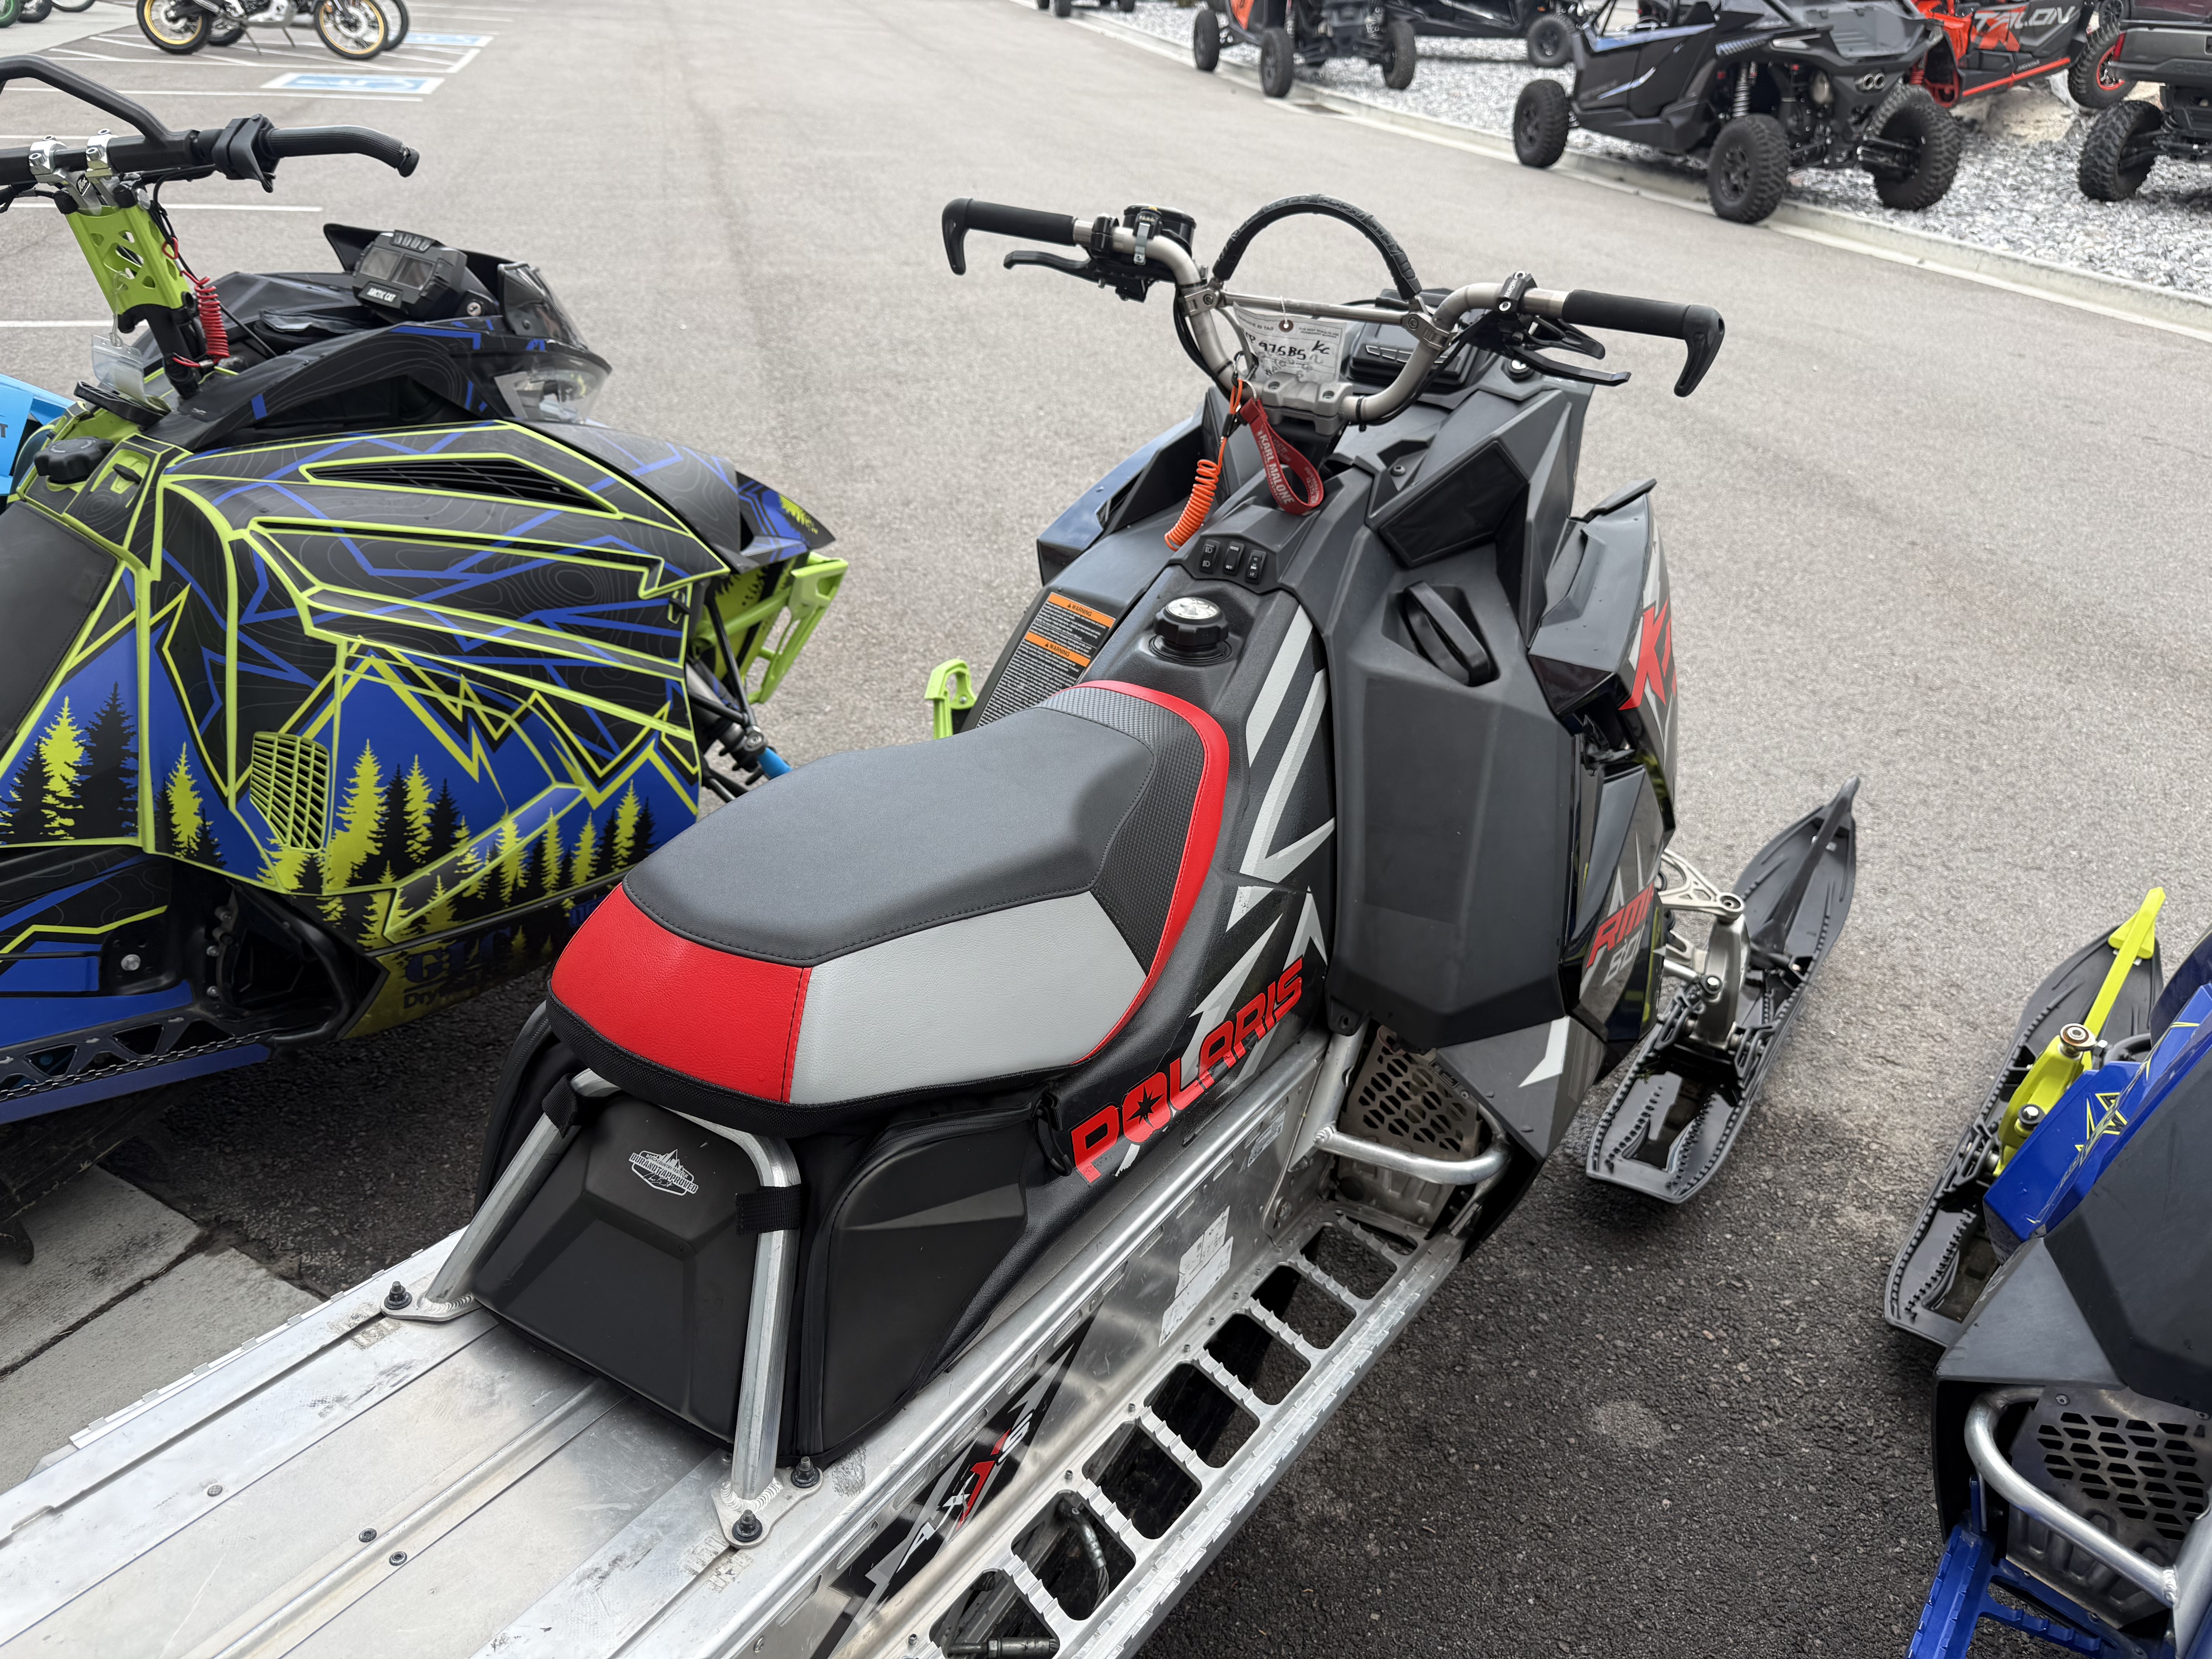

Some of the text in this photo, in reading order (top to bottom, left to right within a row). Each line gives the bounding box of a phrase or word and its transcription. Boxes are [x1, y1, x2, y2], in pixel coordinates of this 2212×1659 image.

[1974, 5, 2076, 33] TALON
[1260, 434, 1274, 464] KARL
[1270, 463, 1294, 504] MALONE
[1072, 603, 1092, 617] WARNING
[1049, 642, 1070, 658] WARNING
[1070, 957, 1303, 1183] POLARIS
